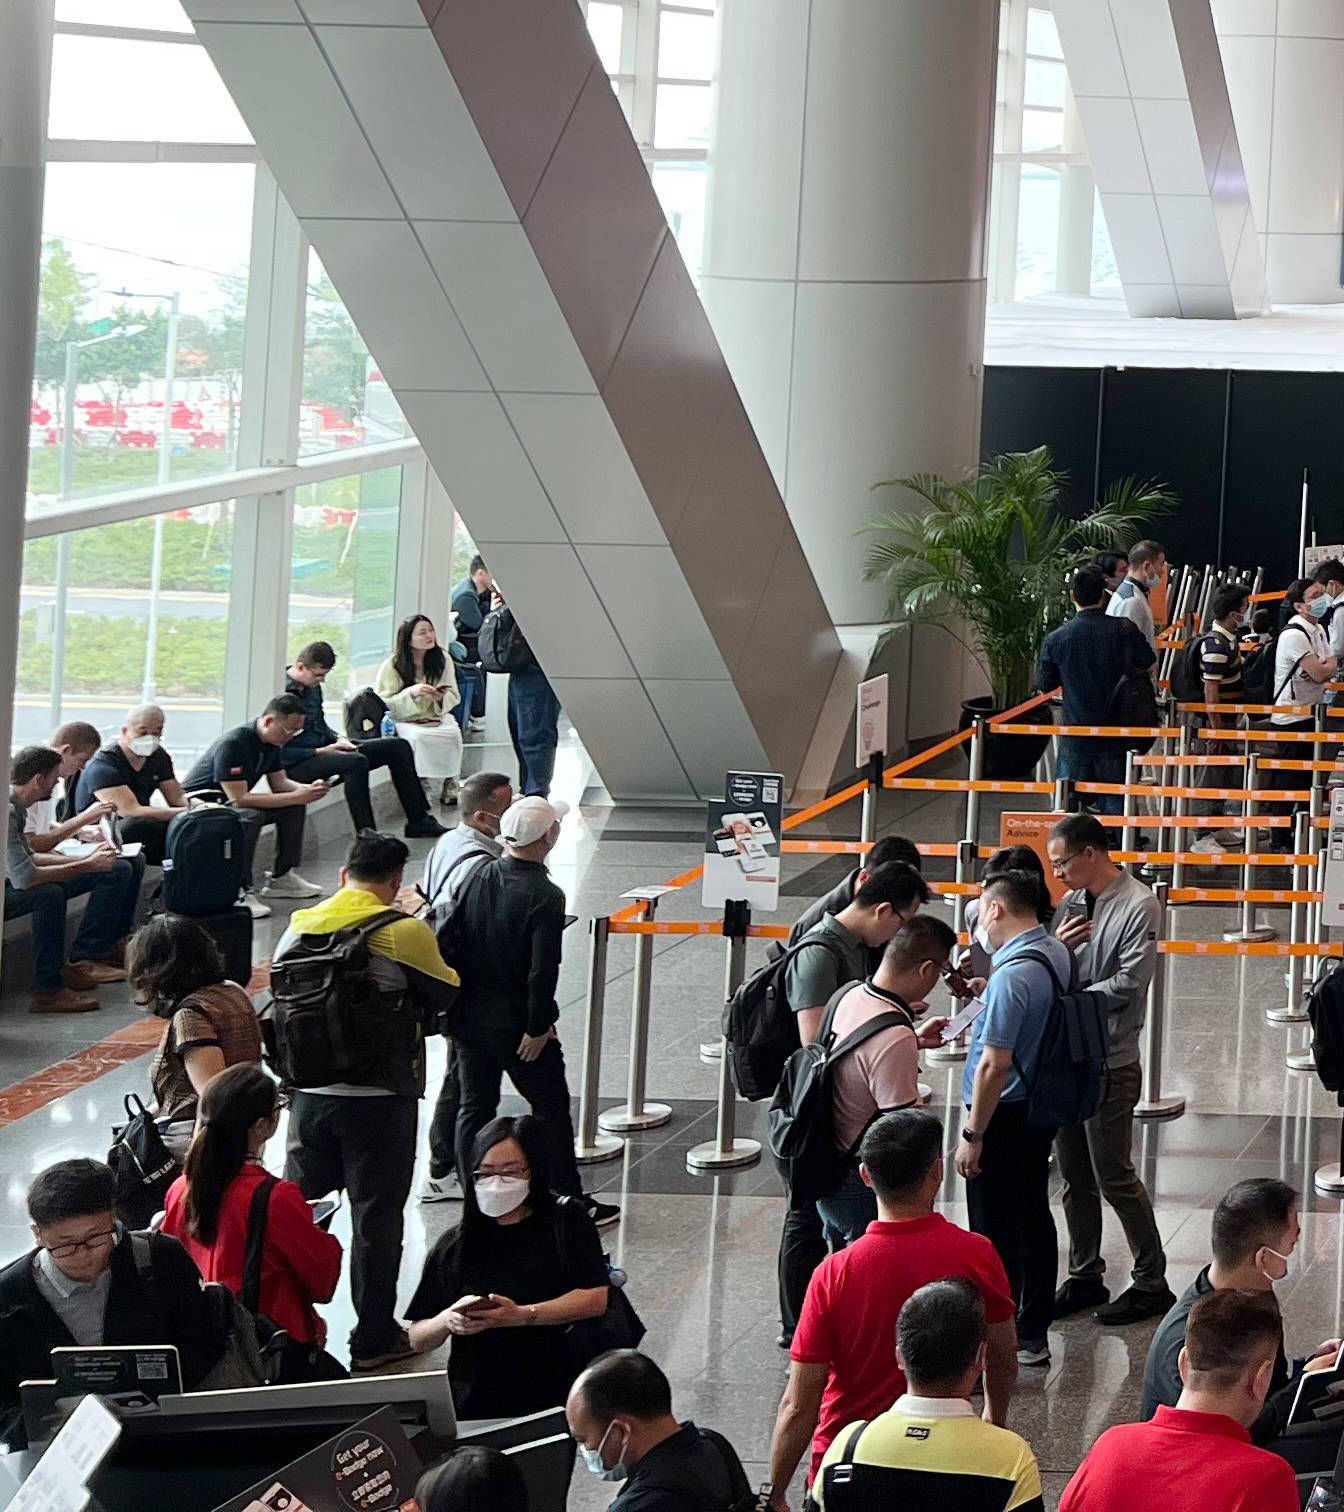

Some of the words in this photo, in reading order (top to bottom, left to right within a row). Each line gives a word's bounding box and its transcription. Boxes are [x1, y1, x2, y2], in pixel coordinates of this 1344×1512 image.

[335, 1457, 368, 1481] e-Badge
[366, 1445, 384, 1461] now
[336, 1449, 353, 1464] Get
[351, 1438, 370, 1457] your
